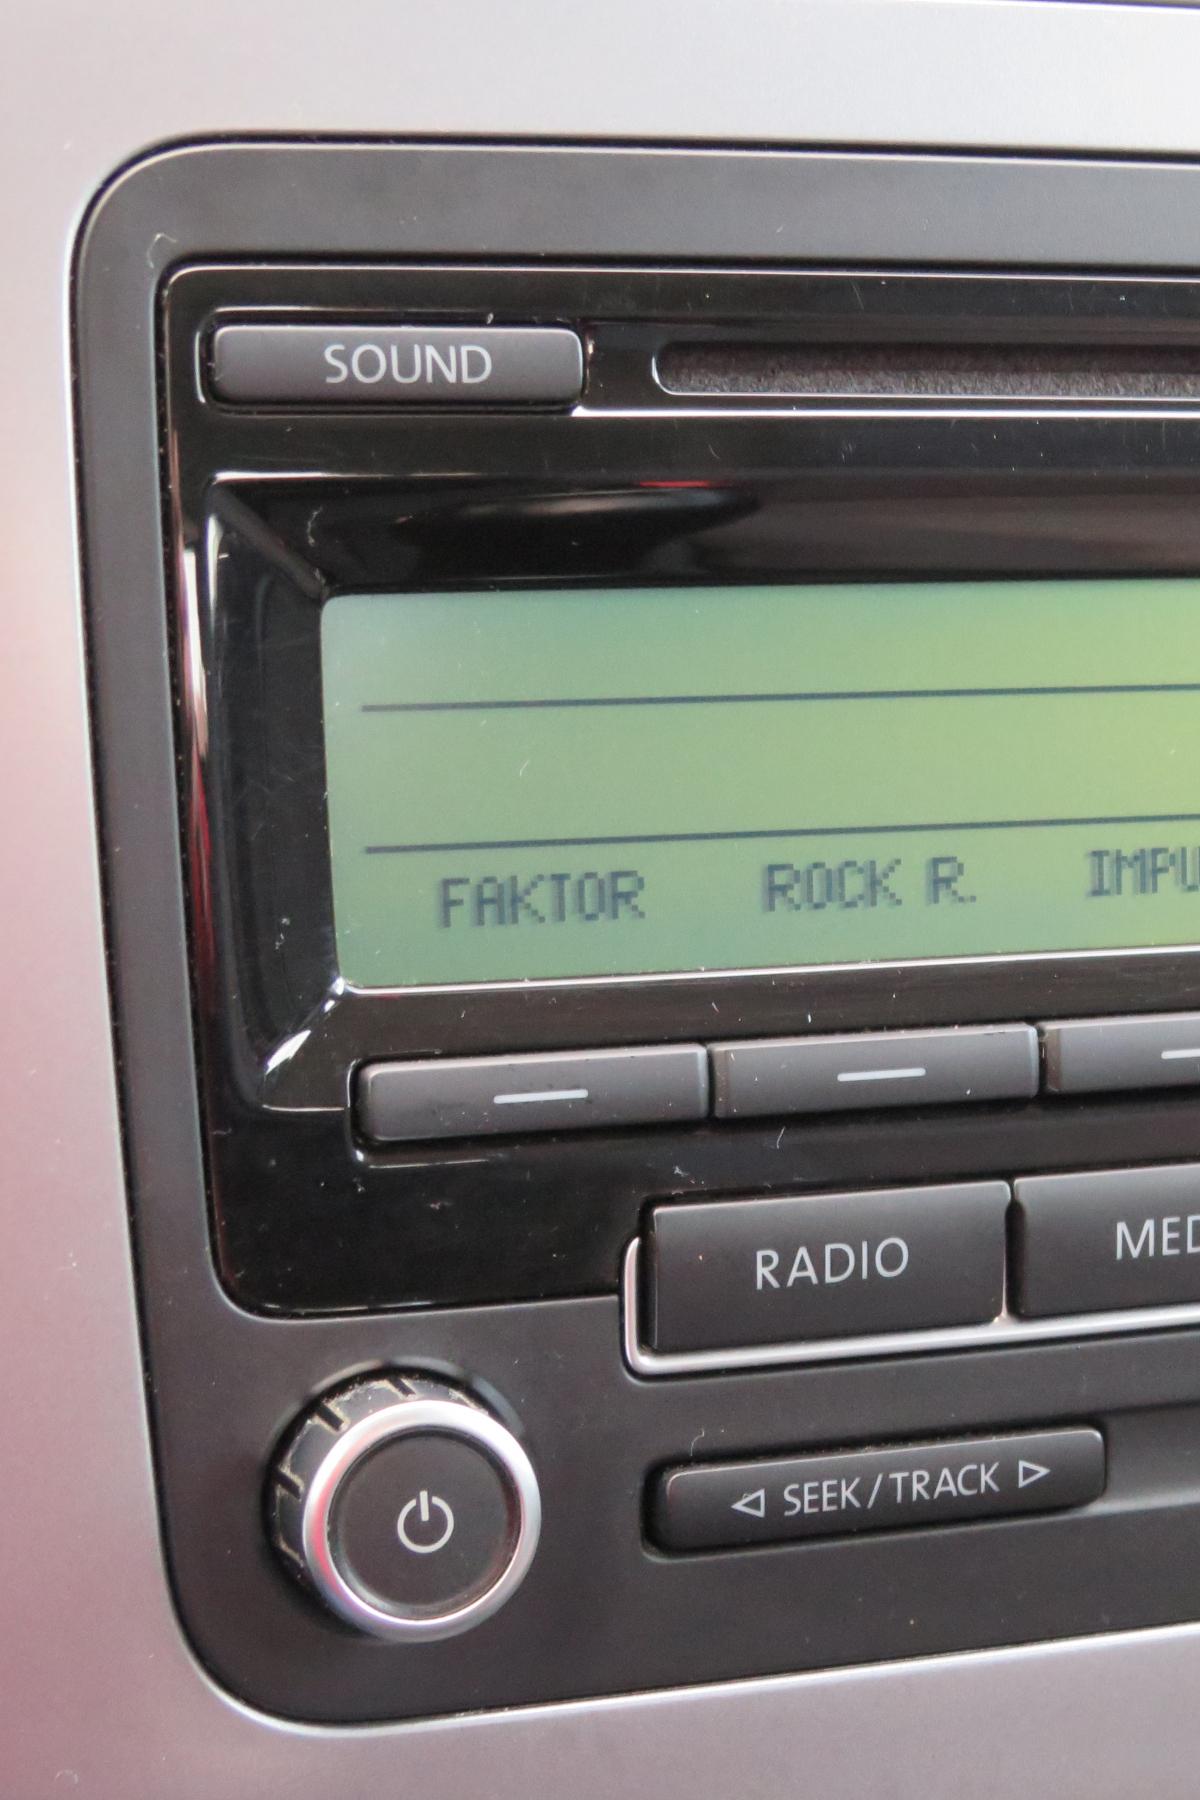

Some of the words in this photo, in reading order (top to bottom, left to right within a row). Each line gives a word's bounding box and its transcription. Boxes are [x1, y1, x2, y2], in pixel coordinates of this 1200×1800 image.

[324, 343, 493, 384] SOUND
[438, 870, 645, 928] FAKTOR
[763, 858, 902, 911] ROCK
[926, 856, 976, 905] R.
[755, 1236, 909, 1290] RADIO
